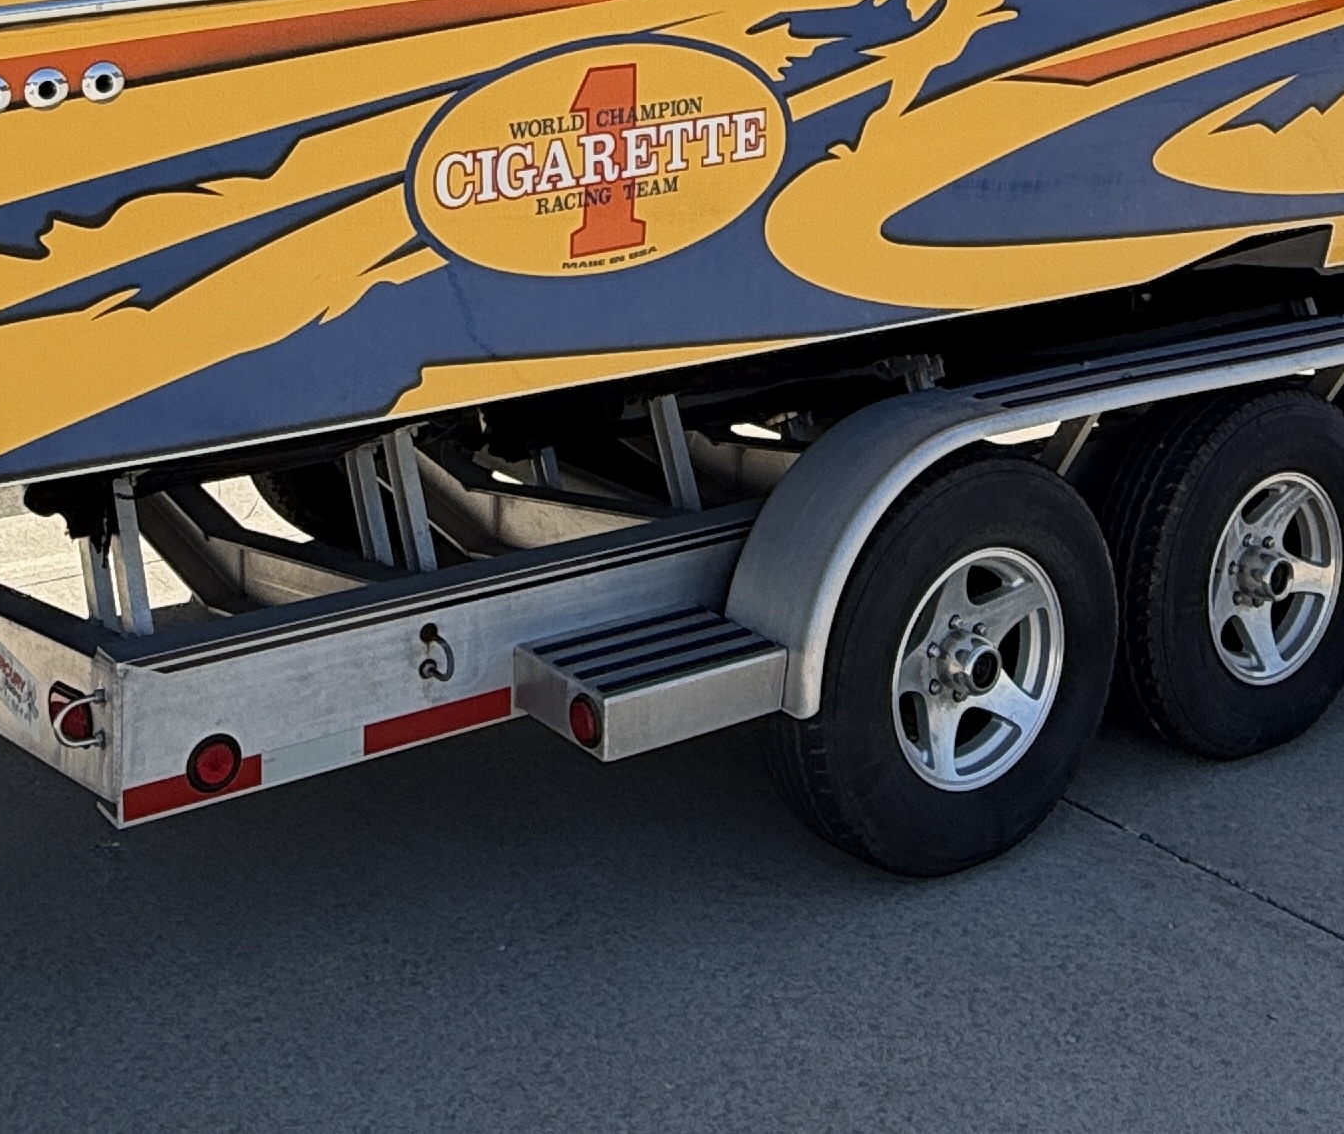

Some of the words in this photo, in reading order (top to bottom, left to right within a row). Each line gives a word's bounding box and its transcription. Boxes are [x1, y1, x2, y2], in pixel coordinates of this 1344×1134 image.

[509, 114, 585, 140] WORLD
[596, 96, 704, 128] CHAMPION
[433, 107, 767, 211] CIGARETTE
[534, 186, 612, 216] RACING
[623, 175, 680, 202] TEAM
[570, 62, 647, 260] 1
